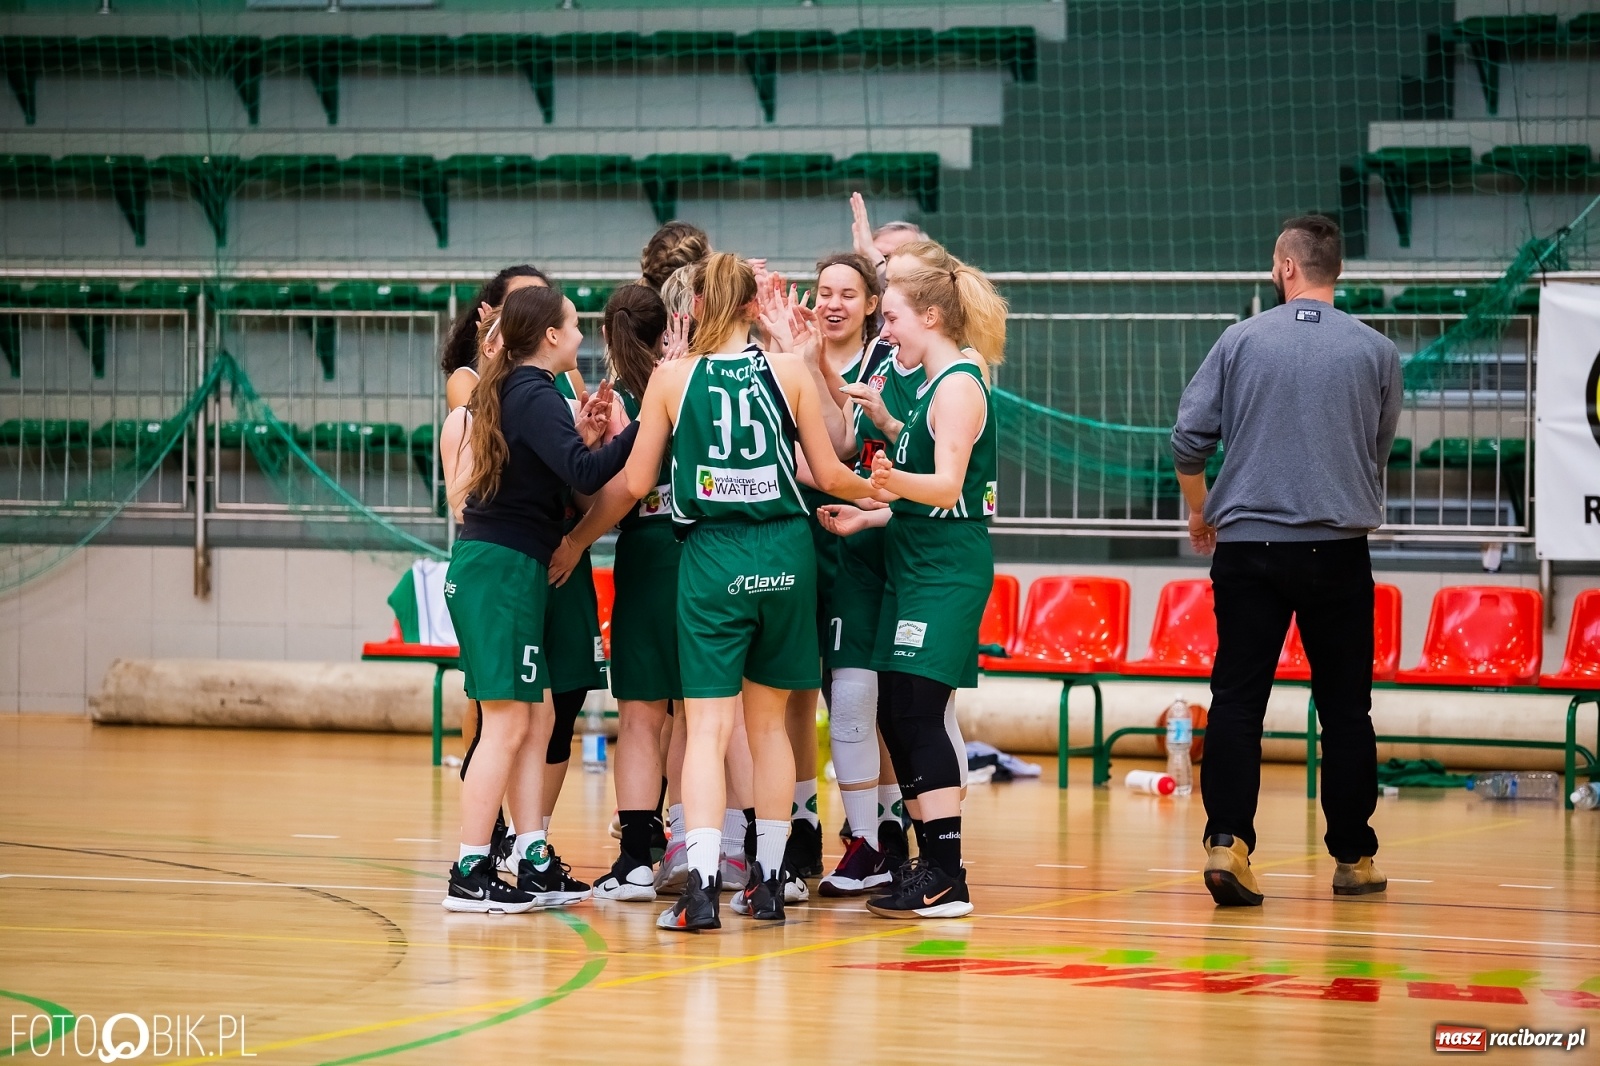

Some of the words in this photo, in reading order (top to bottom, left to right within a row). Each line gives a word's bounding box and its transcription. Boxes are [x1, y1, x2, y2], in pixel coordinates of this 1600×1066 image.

[708, 386, 767, 460] 35
[896, 432, 910, 464] 8
[745, 572, 795, 590] Clavis
[521, 645, 539, 683] 5
